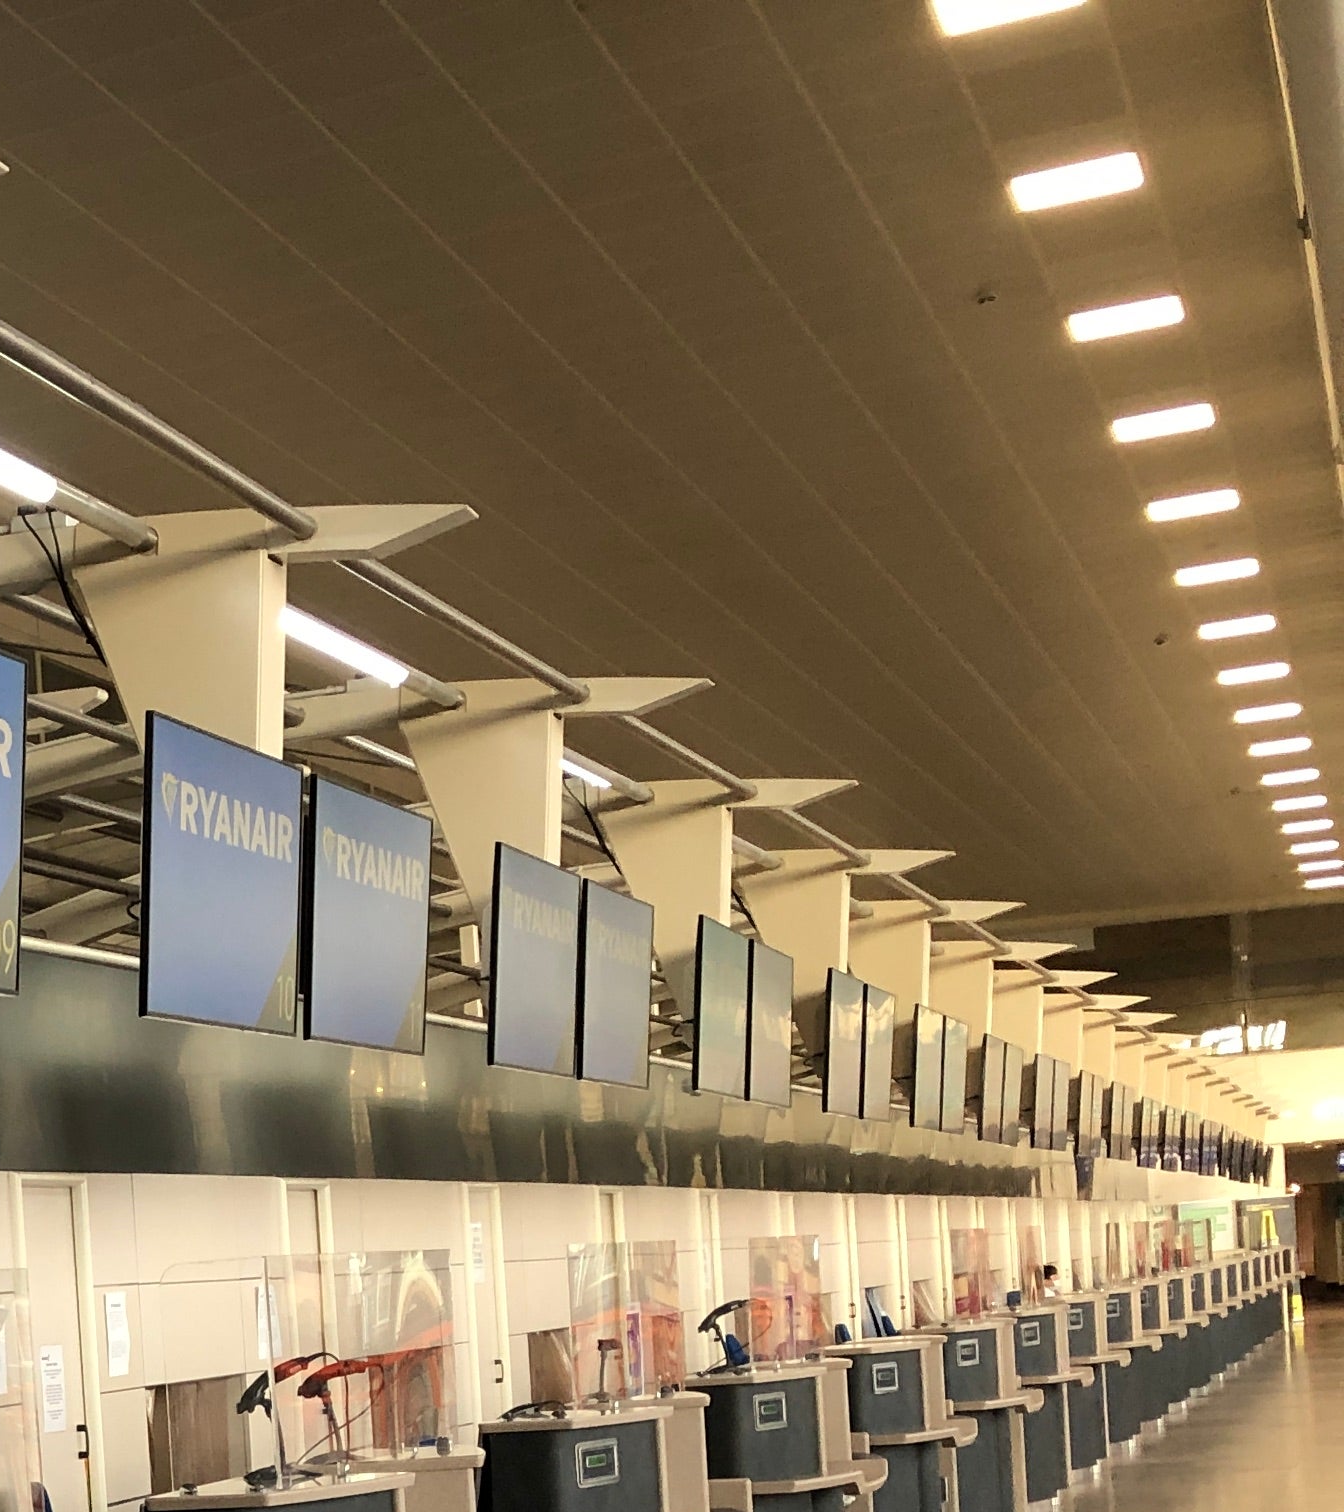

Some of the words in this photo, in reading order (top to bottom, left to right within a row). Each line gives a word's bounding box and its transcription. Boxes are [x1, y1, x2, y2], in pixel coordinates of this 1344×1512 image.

[180, 781, 294, 864] RYANAIR
[335, 833, 425, 902] RYANAIR
[277, 975, 295, 1021] 10
